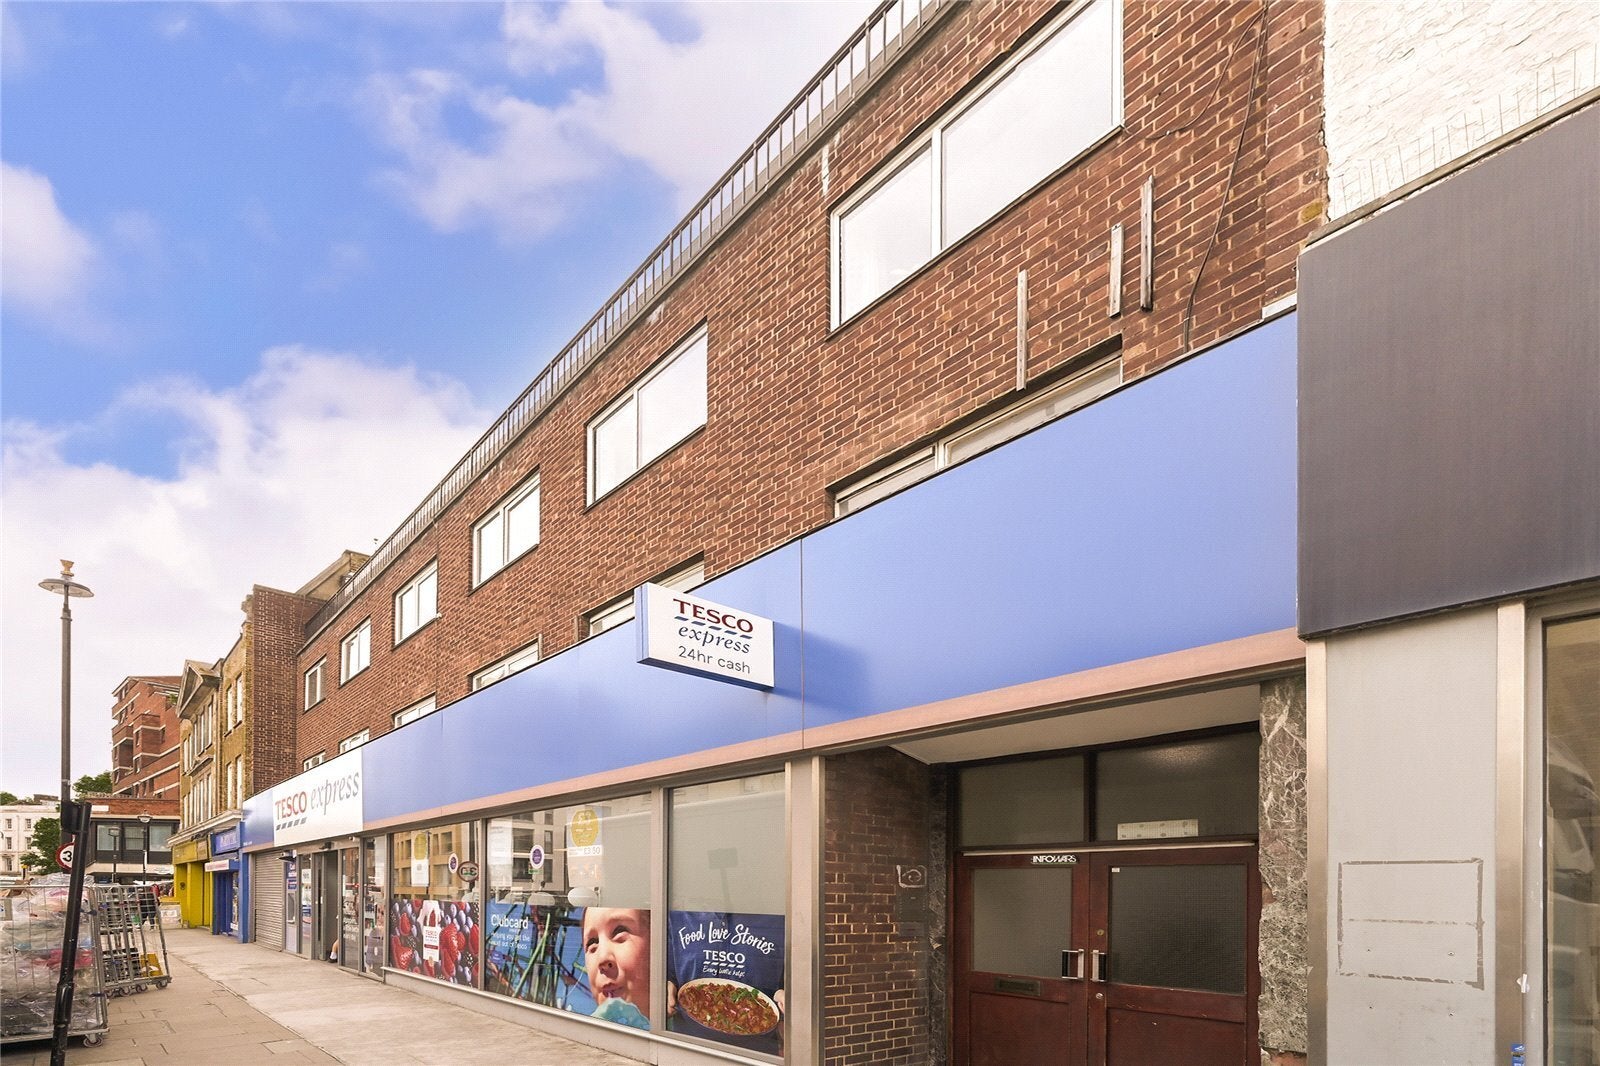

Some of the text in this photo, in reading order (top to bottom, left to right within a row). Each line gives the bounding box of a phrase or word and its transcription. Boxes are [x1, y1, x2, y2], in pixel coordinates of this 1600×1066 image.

[673, 598, 754, 633] TESCO
[678, 625, 750, 654] express
[678, 645, 751, 674] 24hr cash
[274, 772, 360, 820] TESCO express
[62, 850, 73, 862] 3
[1032, 855, 1077, 863] INFOWARS
[491, 914, 529, 929] Clubcard
[678, 921, 776, 955] Food Love Stories
[703, 949, 746, 964] TESCO
[702, 965, 718, 976] Every
